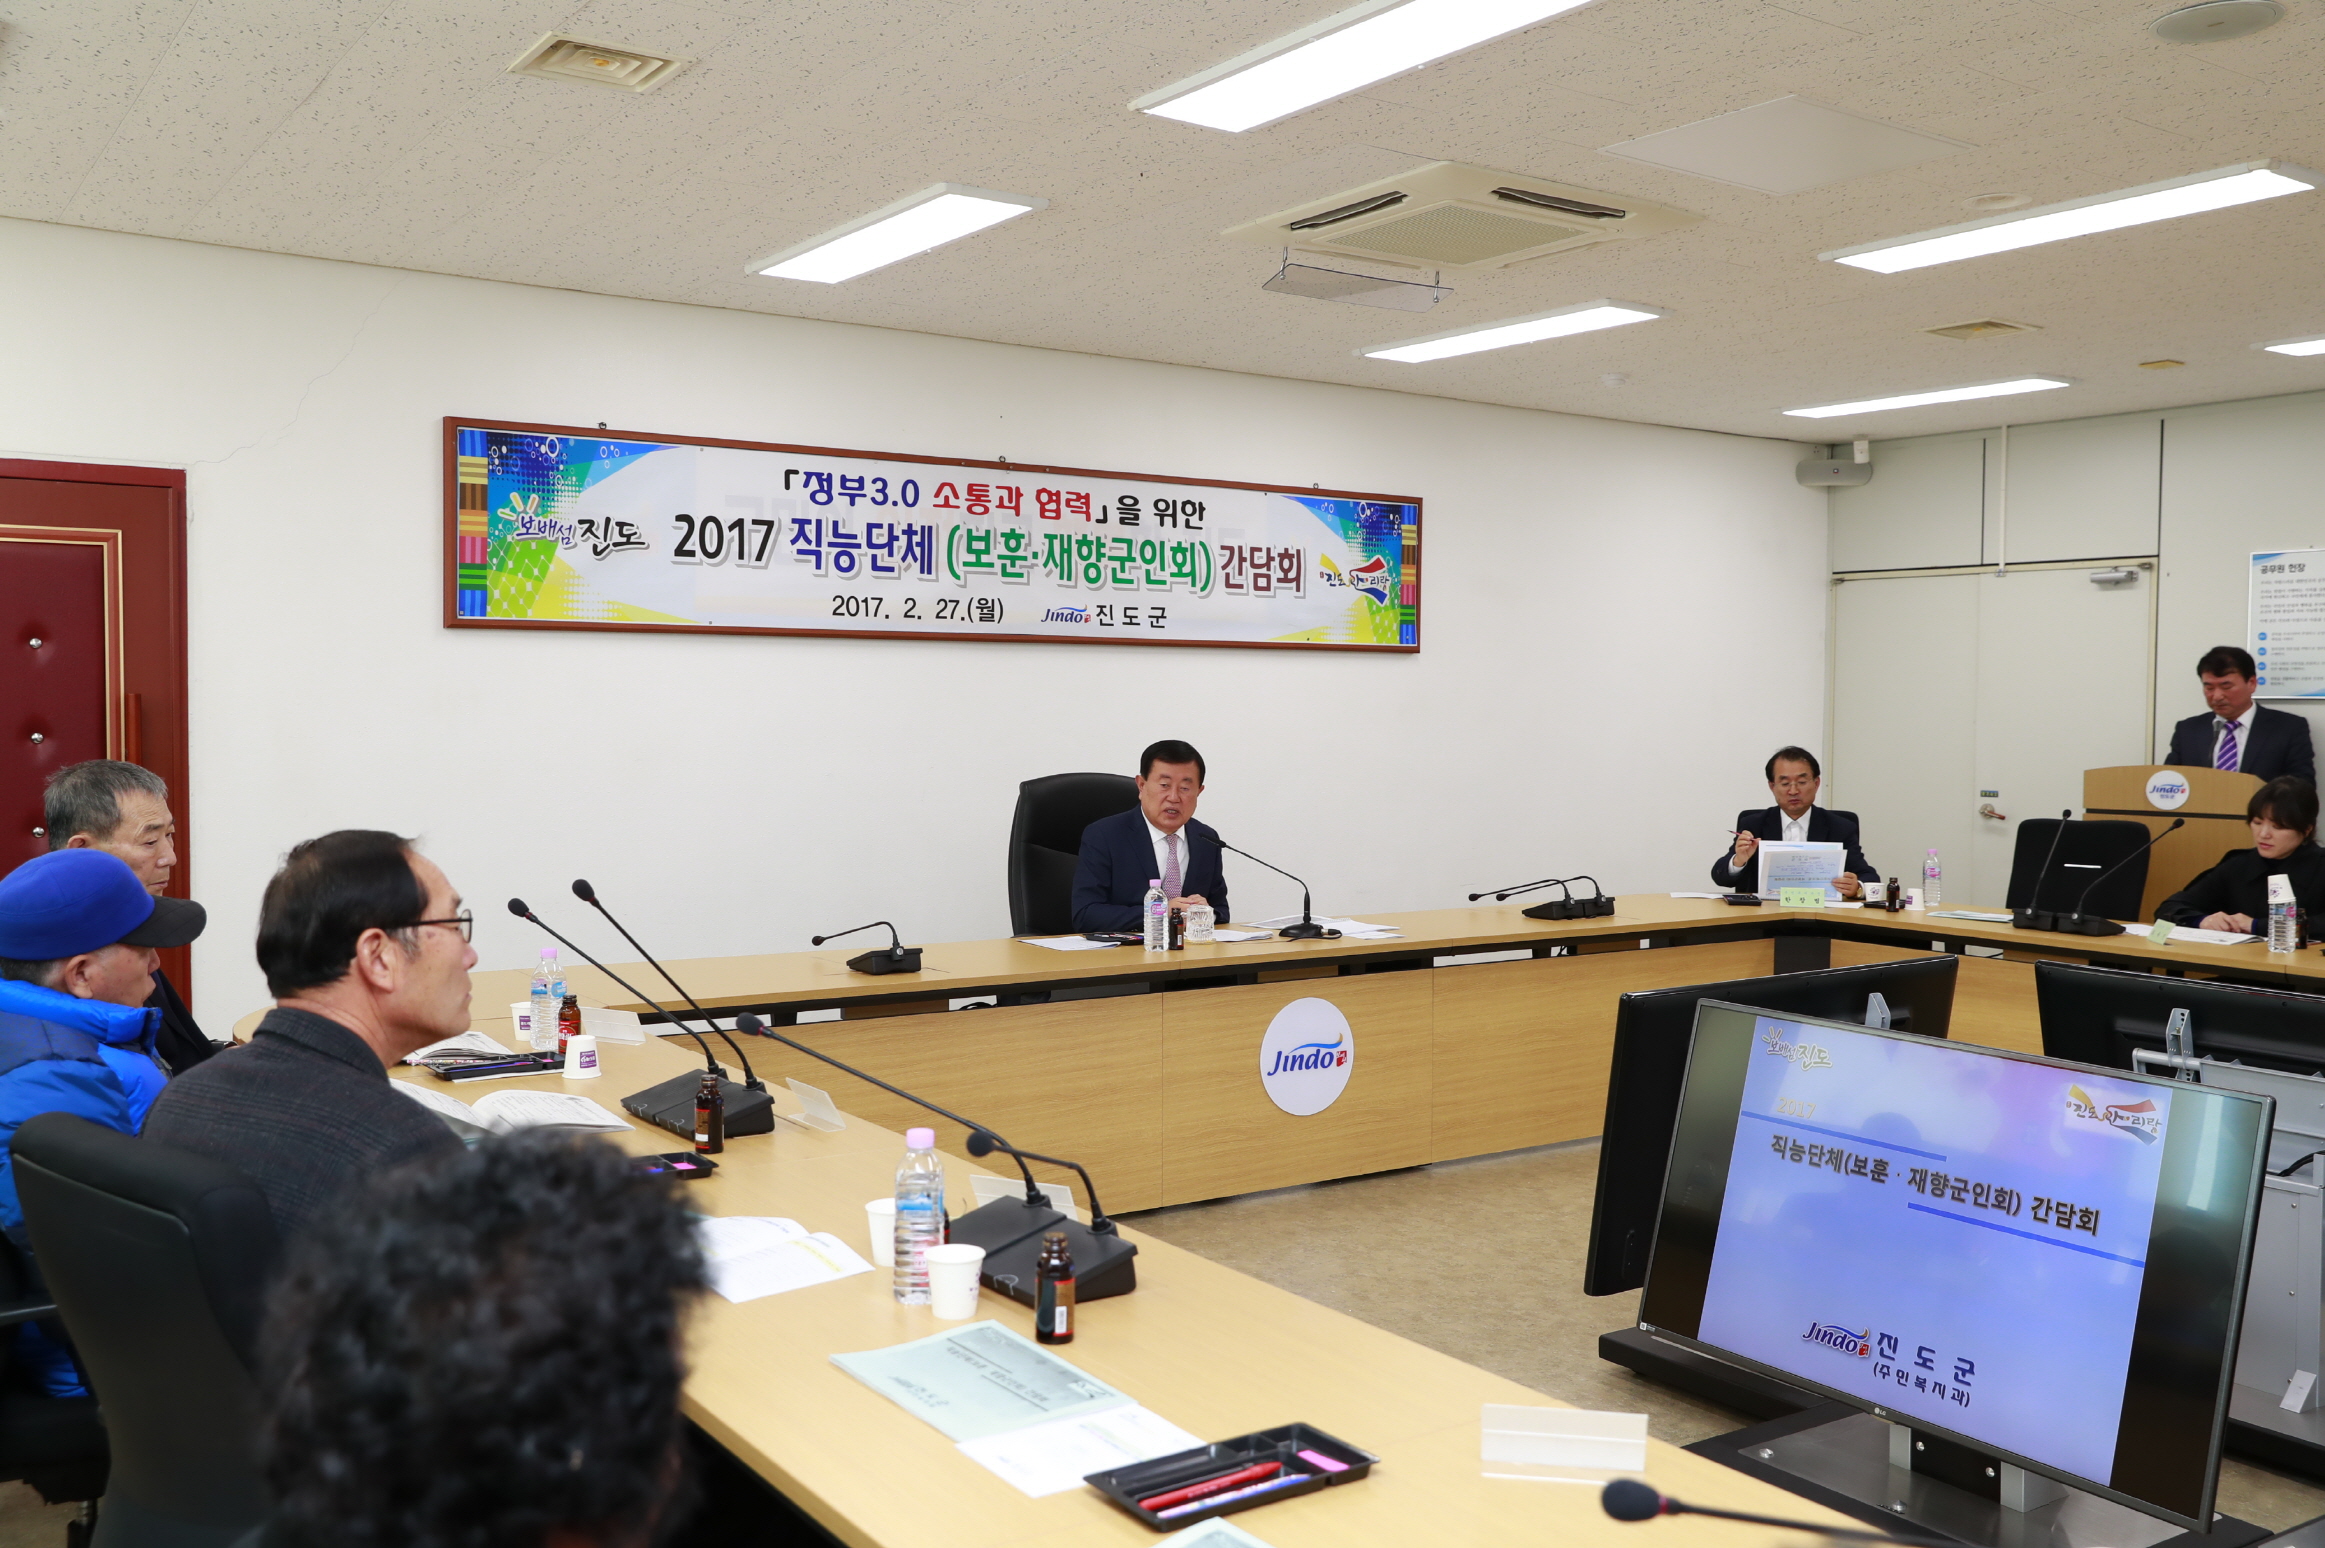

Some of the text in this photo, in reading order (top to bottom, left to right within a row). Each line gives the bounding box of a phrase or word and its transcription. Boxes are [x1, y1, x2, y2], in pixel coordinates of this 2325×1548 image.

[933, 482, 1023, 517] 소통과
[1036, 488, 1141, 526] 협력」을
[1154, 499, 1205, 530] 위한
[516, 515, 646, 556] 보배섬 진도
[673, 514, 774, 562] 2017
[790, 518, 934, 575] 직능단체
[1221, 544, 1303, 592] 간담회
[832, 595, 1004, 624] 2017. 2. 27.(월)
[1040, 607, 1084, 624] Jindo
[2149, 785, 2180, 794] Jindo
[1266, 1048, 1335, 1077] Jindo
[1798, 1044, 1832, 1069] 진도
[1776, 1096, 1817, 1119] 2017
[2030, 1195, 2100, 1237] 간담회
[1802, 1321, 1859, 1354] Jindo
